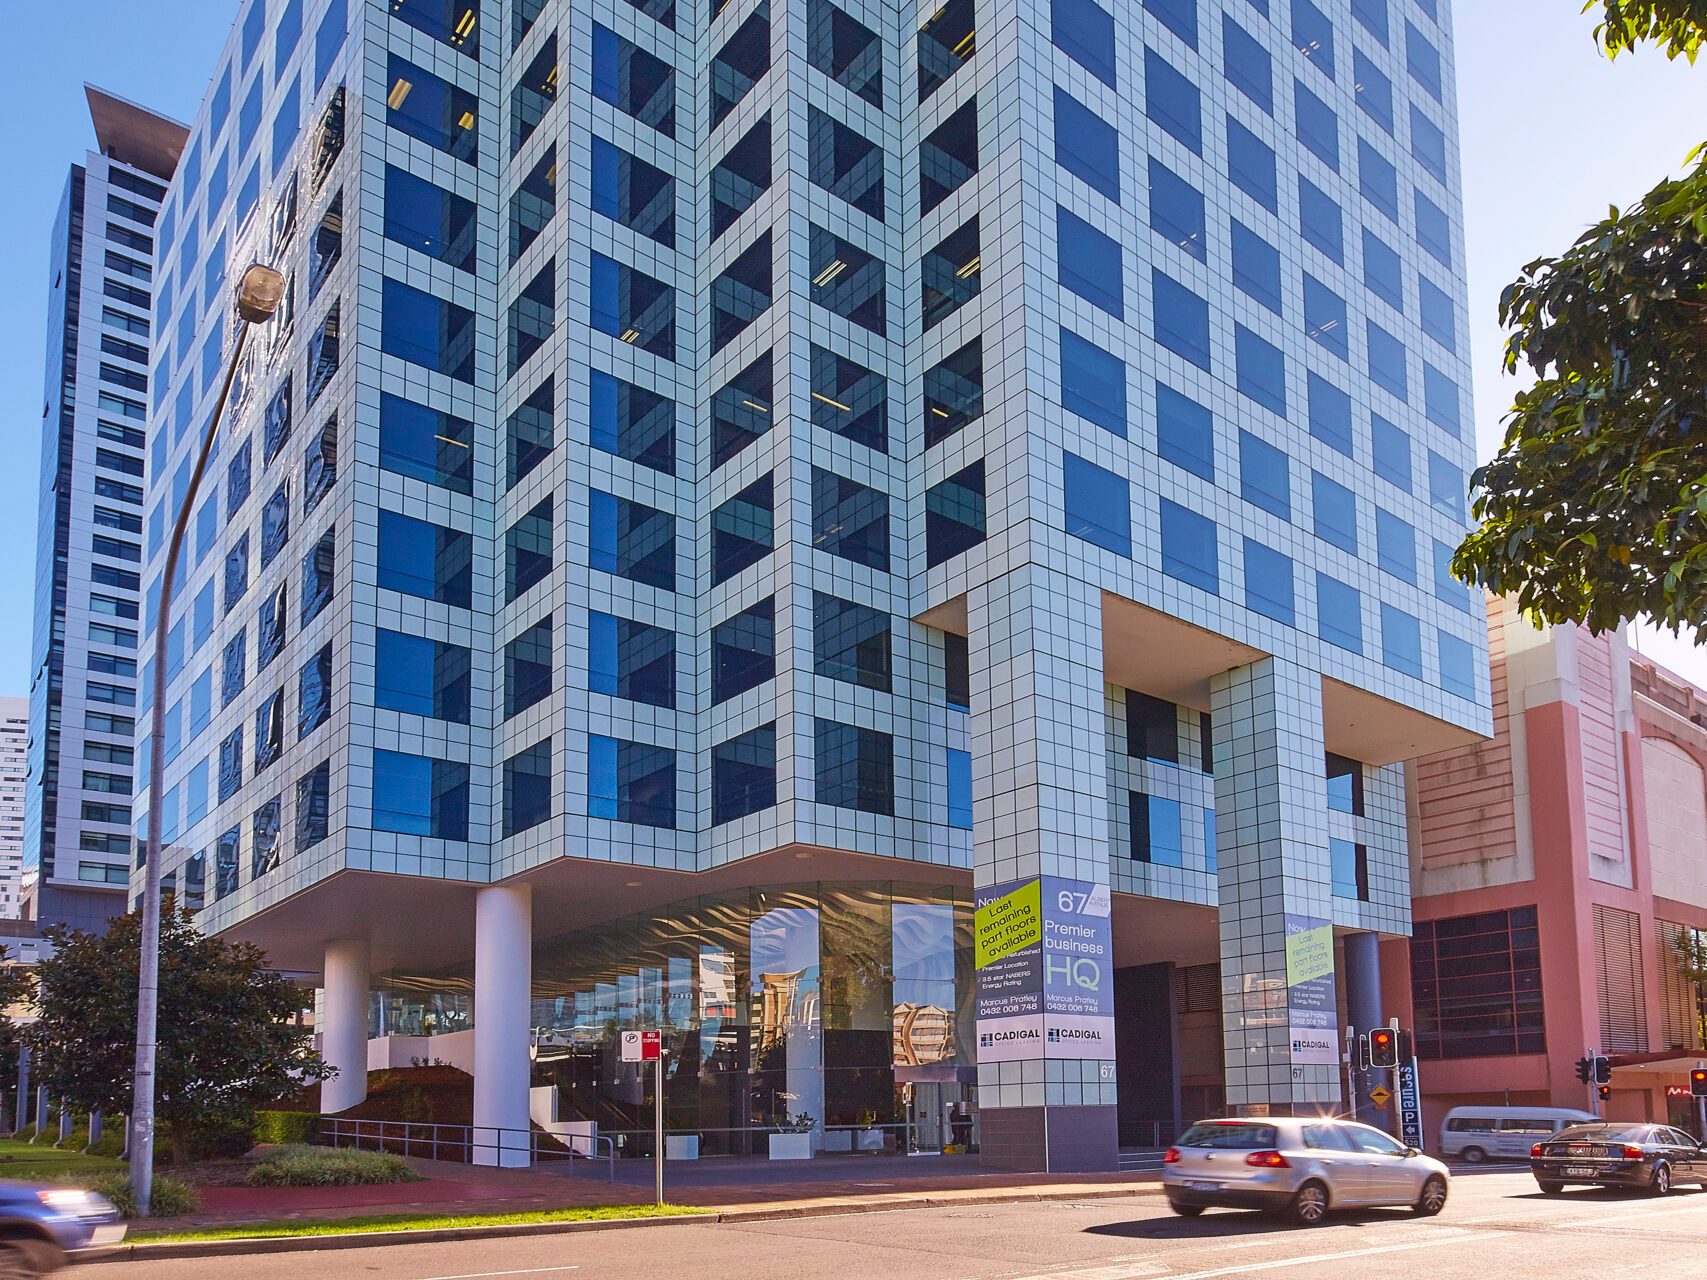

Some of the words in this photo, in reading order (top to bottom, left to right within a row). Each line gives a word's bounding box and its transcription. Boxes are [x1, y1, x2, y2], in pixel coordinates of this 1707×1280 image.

[1058, 890, 1088, 914] 67
[989, 900, 1012, 918] Last
[979, 904, 1031, 935] remaining
[981, 931, 1003, 949] part
[1006, 915, 1037, 936] floors
[1044, 920, 1096, 938] Premier
[1288, 923, 1306, 933] Now
[989, 928, 1036, 957] available
[1045, 935, 1104, 955] business
[1299, 934, 1313, 944] Last
[1293, 943, 1325, 958] remaining
[1004, 961, 1029, 969] Location
[1294, 957, 1308, 968] part
[1309, 952, 1328, 963] floors
[1005, 970, 1031, 979] NABERS
[1046, 954, 1100, 992] HQ
[1300, 962, 1328, 976] available
[982, 982, 1003, 990] Energy
[980, 998, 1008, 1007] Marcus
[1010, 994, 1038, 1003] Pratley
[1047, 994, 1073, 1003] Marcus
[1074, 996, 1098, 1006] Pratley
[980, 1005, 1001, 1016] 0432
[1021, 1002, 1038, 1011] 748
[1047, 1002, 1067, 1011] 0432
[1084, 1005, 1098, 1013] 748
[994, 1029, 1041, 1041] CADIGAL
[1061, 1029, 1102, 1040] CADIGAL
[1301, 1040, 1330, 1049] CADIGAL
[1100, 1065, 1115, 1078] 67
[1292, 1068, 1303, 1079] 67
[1405, 1111, 1415, 1122] P
